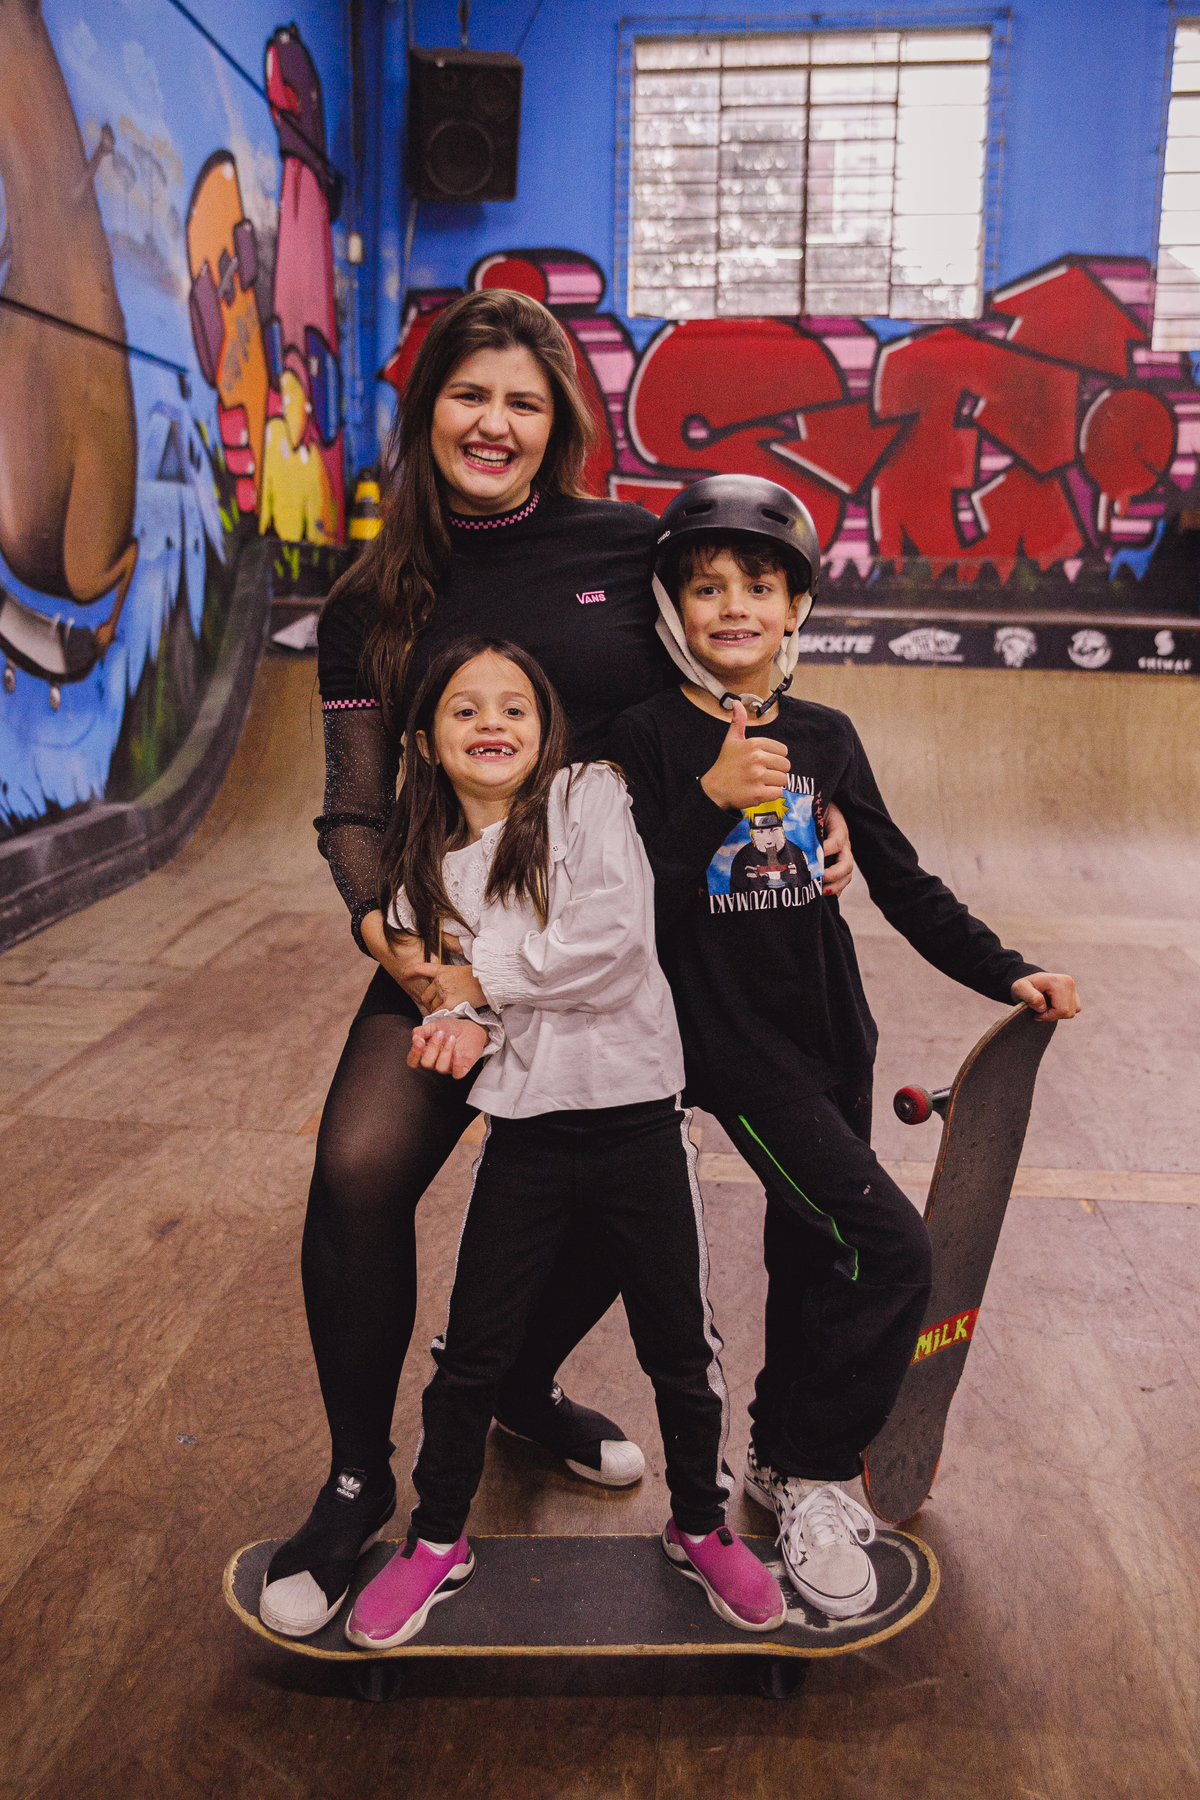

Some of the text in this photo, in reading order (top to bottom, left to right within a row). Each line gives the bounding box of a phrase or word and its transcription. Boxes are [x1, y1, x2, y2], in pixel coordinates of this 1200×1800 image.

[575, 590, 607, 604] VANS
[781, 773, 815, 796] MAKI
[709, 876, 823, 914] ARUTO UZUMAKI
